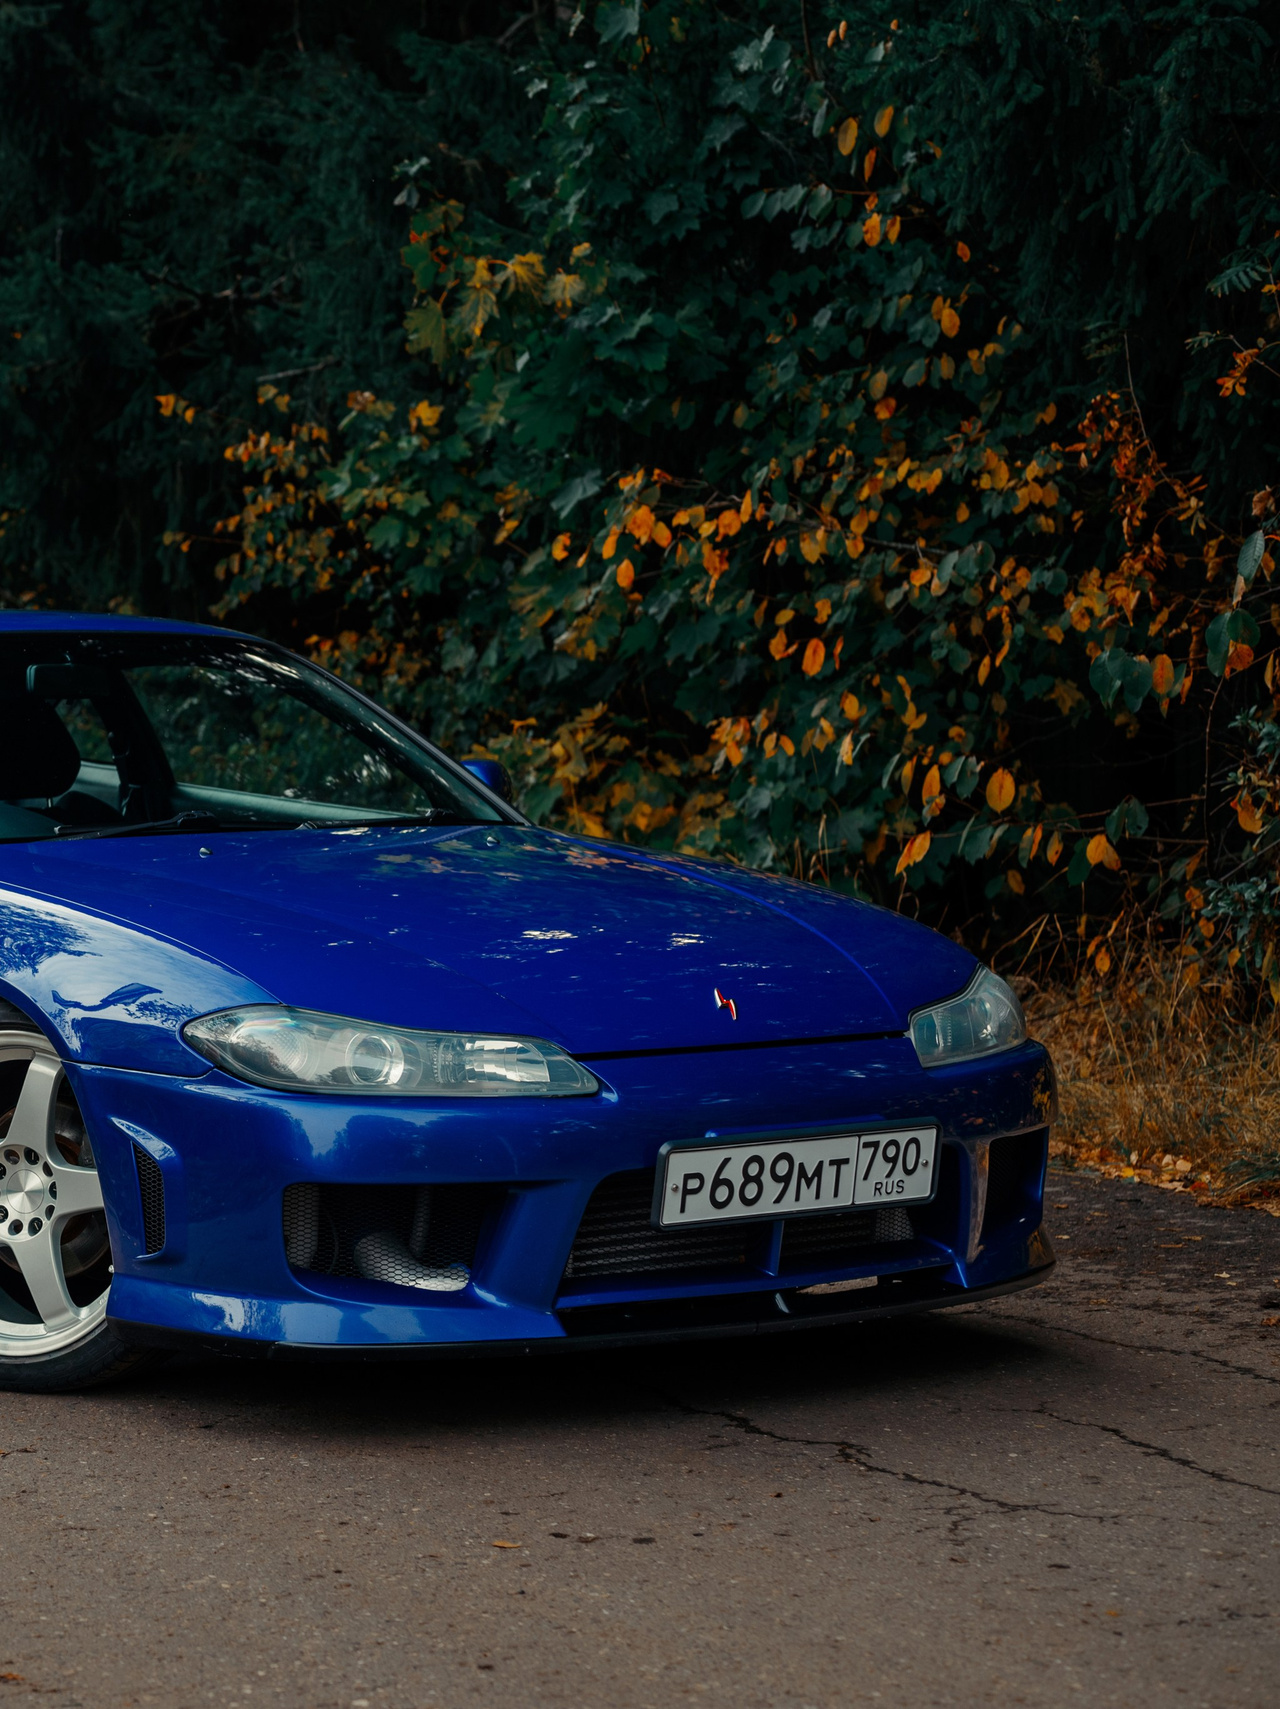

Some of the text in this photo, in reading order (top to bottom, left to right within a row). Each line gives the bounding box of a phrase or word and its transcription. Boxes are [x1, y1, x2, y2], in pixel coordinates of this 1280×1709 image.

[680, 1137, 921, 1213] P689MT 790
[873, 1179, 905, 1197] RUS
